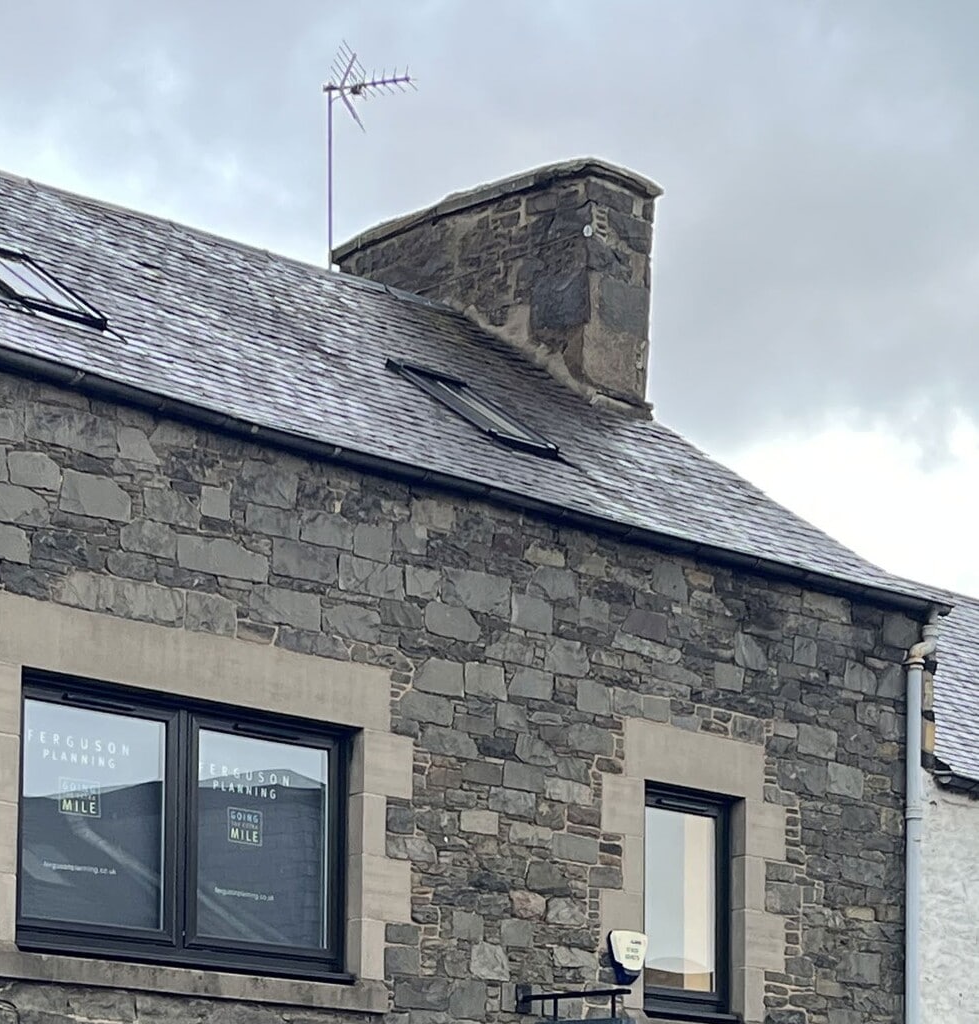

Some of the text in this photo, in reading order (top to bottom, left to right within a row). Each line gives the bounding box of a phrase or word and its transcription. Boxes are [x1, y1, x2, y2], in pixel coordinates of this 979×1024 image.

[27, 729, 130, 757] FERGUSON
[43, 748, 116, 769] PLANNING
[199, 761, 290, 787] FERGUSON
[212, 779, 277, 800] PLANNING
[62, 799, 97, 814] MILE
[230, 811, 259, 823] GOING
[230, 827, 259, 843] MILE
